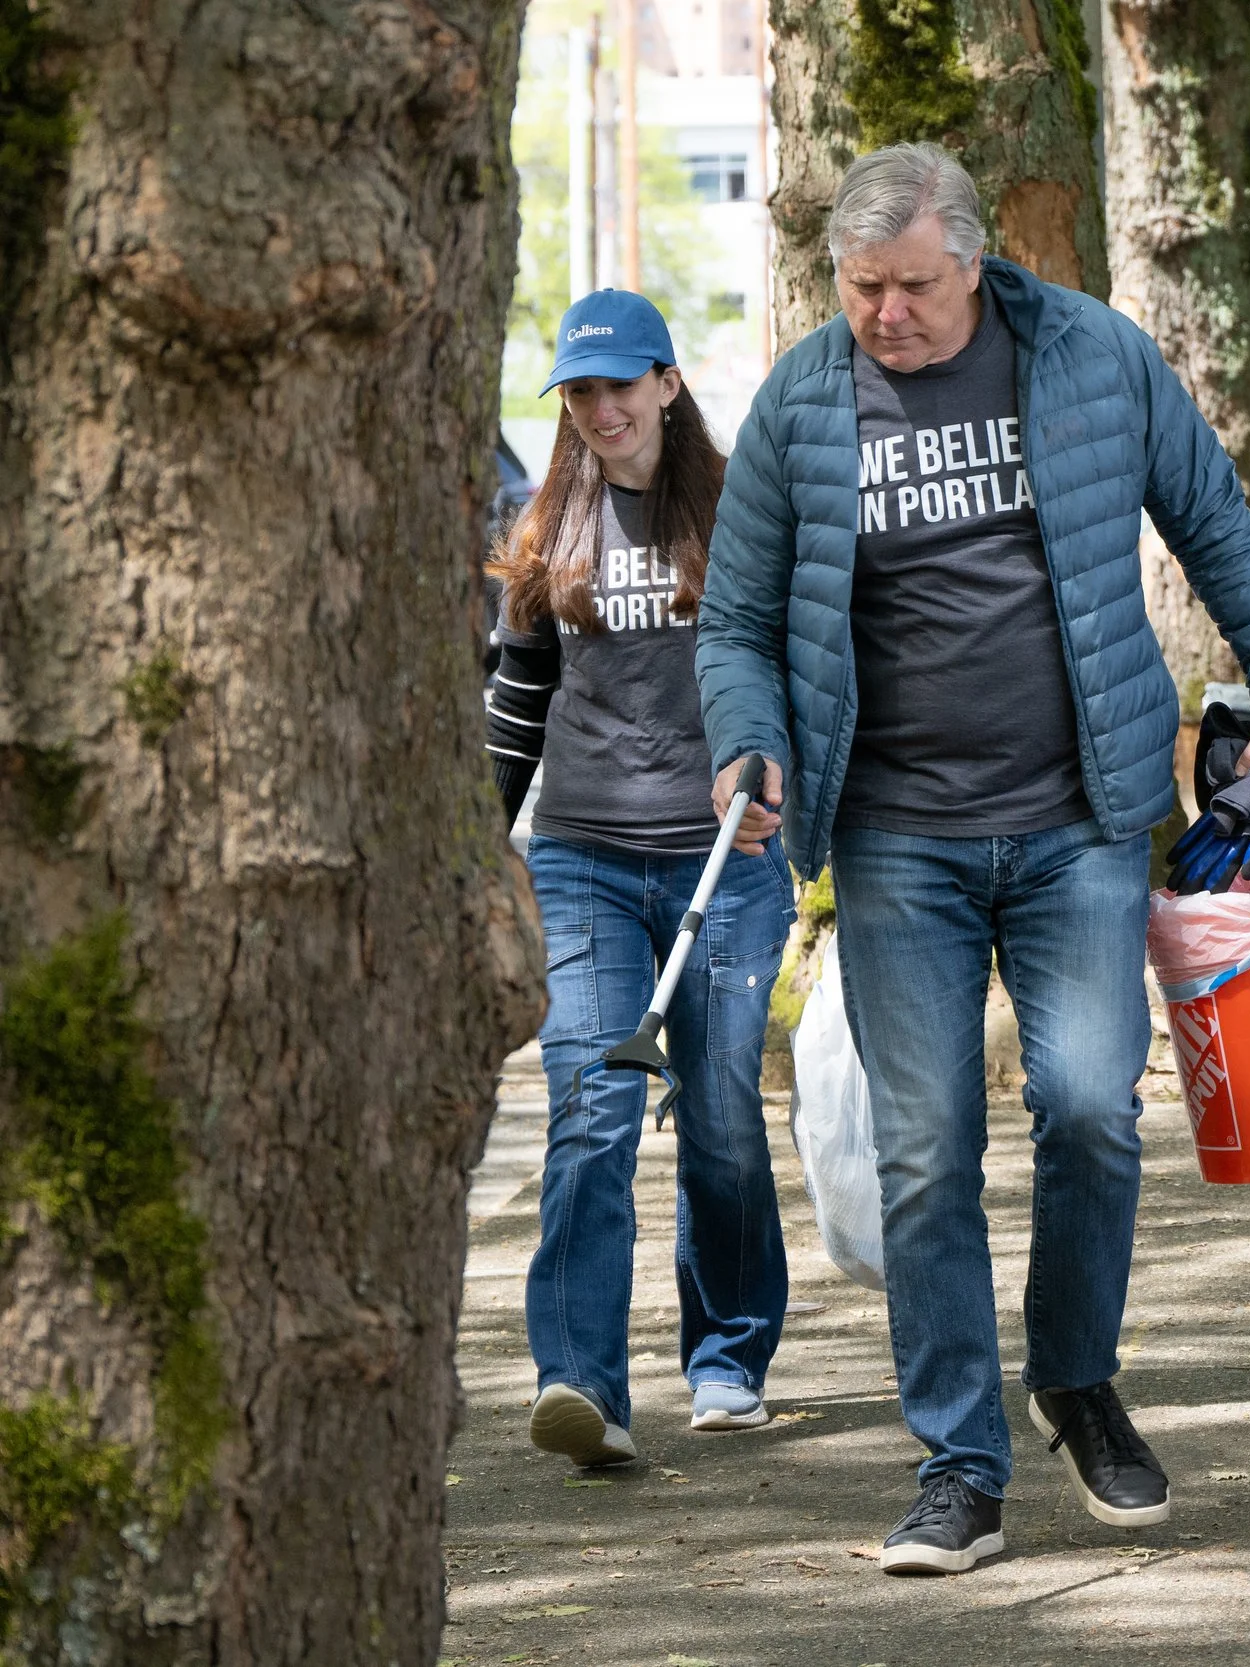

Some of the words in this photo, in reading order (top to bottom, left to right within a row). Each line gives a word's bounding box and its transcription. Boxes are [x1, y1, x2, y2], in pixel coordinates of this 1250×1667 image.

[566, 324, 613, 342] Colliers
[858, 434, 909, 488] WE
[915, 416, 1023, 476] BELIE
[898, 469, 1036, 528] PORTLA
[592, 591, 693, 632] ORTL
